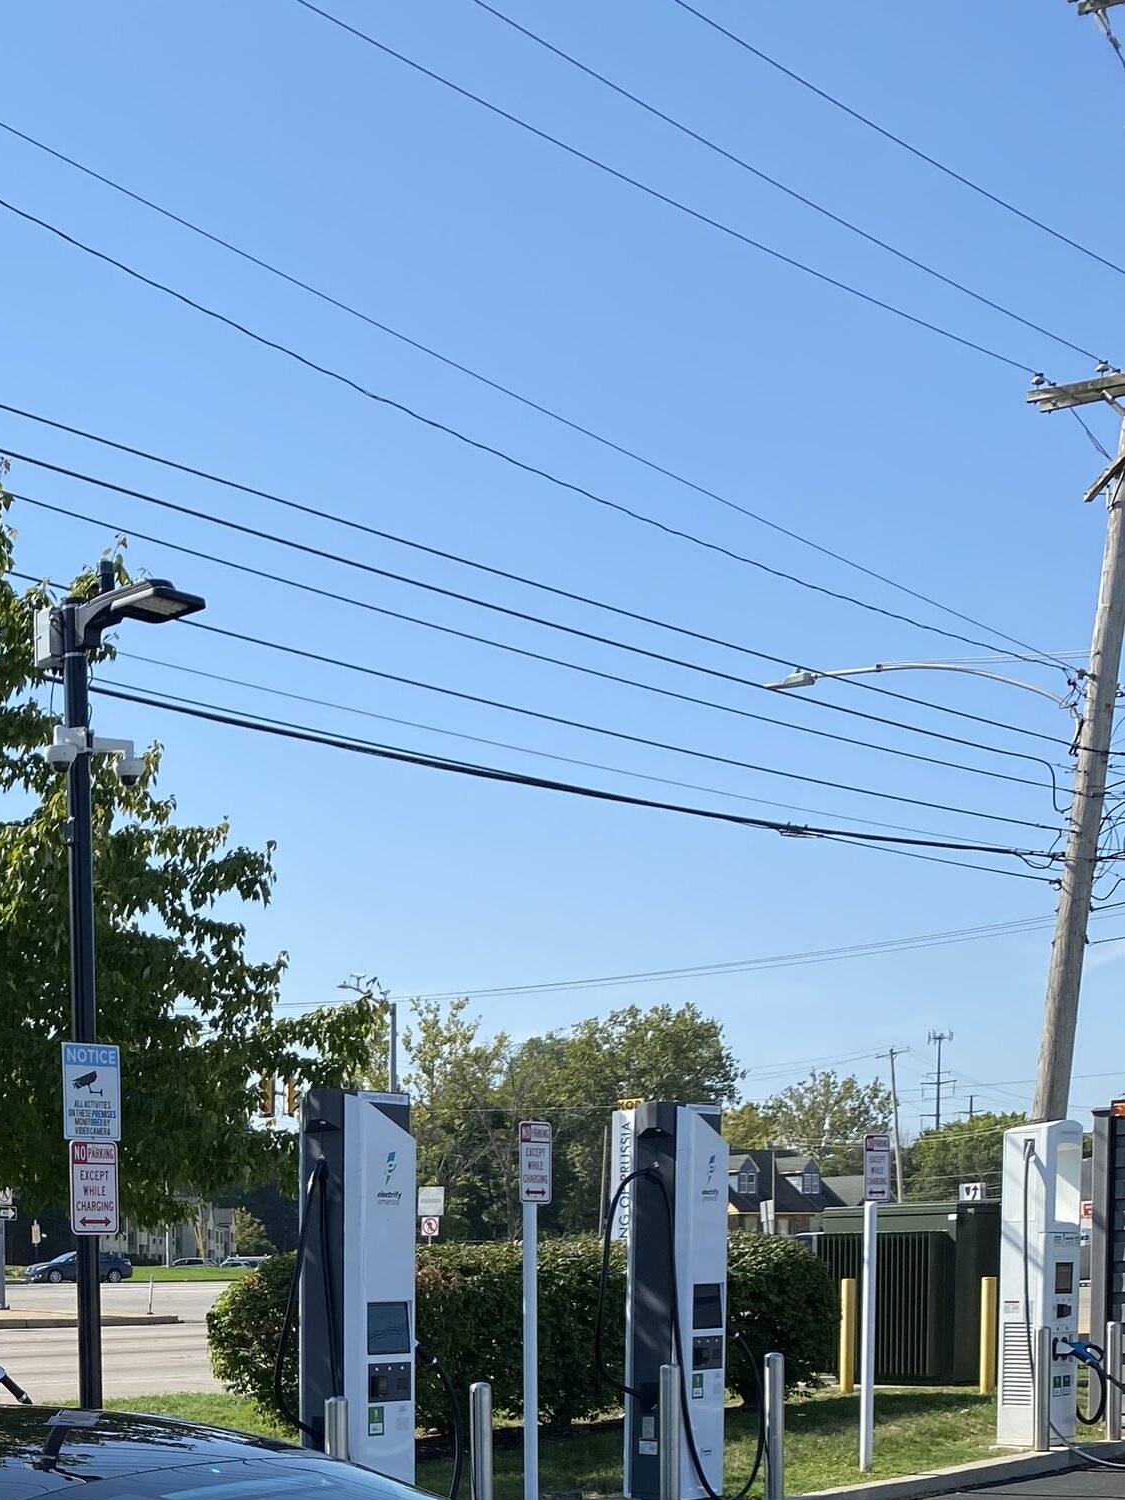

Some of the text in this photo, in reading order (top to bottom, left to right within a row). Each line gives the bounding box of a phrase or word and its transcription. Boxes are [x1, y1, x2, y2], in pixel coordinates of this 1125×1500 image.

[66, 1047, 116, 1065] NOTICE
[84, 1100, 112, 1109] ACTIVITIES
[91, 1110, 117, 1119] PREMISES
[75, 1145, 114, 1161] NO PARKING
[619, 1121, 631, 1181] PRUSSIA
[79, 1169, 109, 1181] EXCEPT
[82, 1185, 107, 1197] WHILE
[377, 1190, 402, 1200] electrify
[76, 1200, 114, 1212] CHARGING
